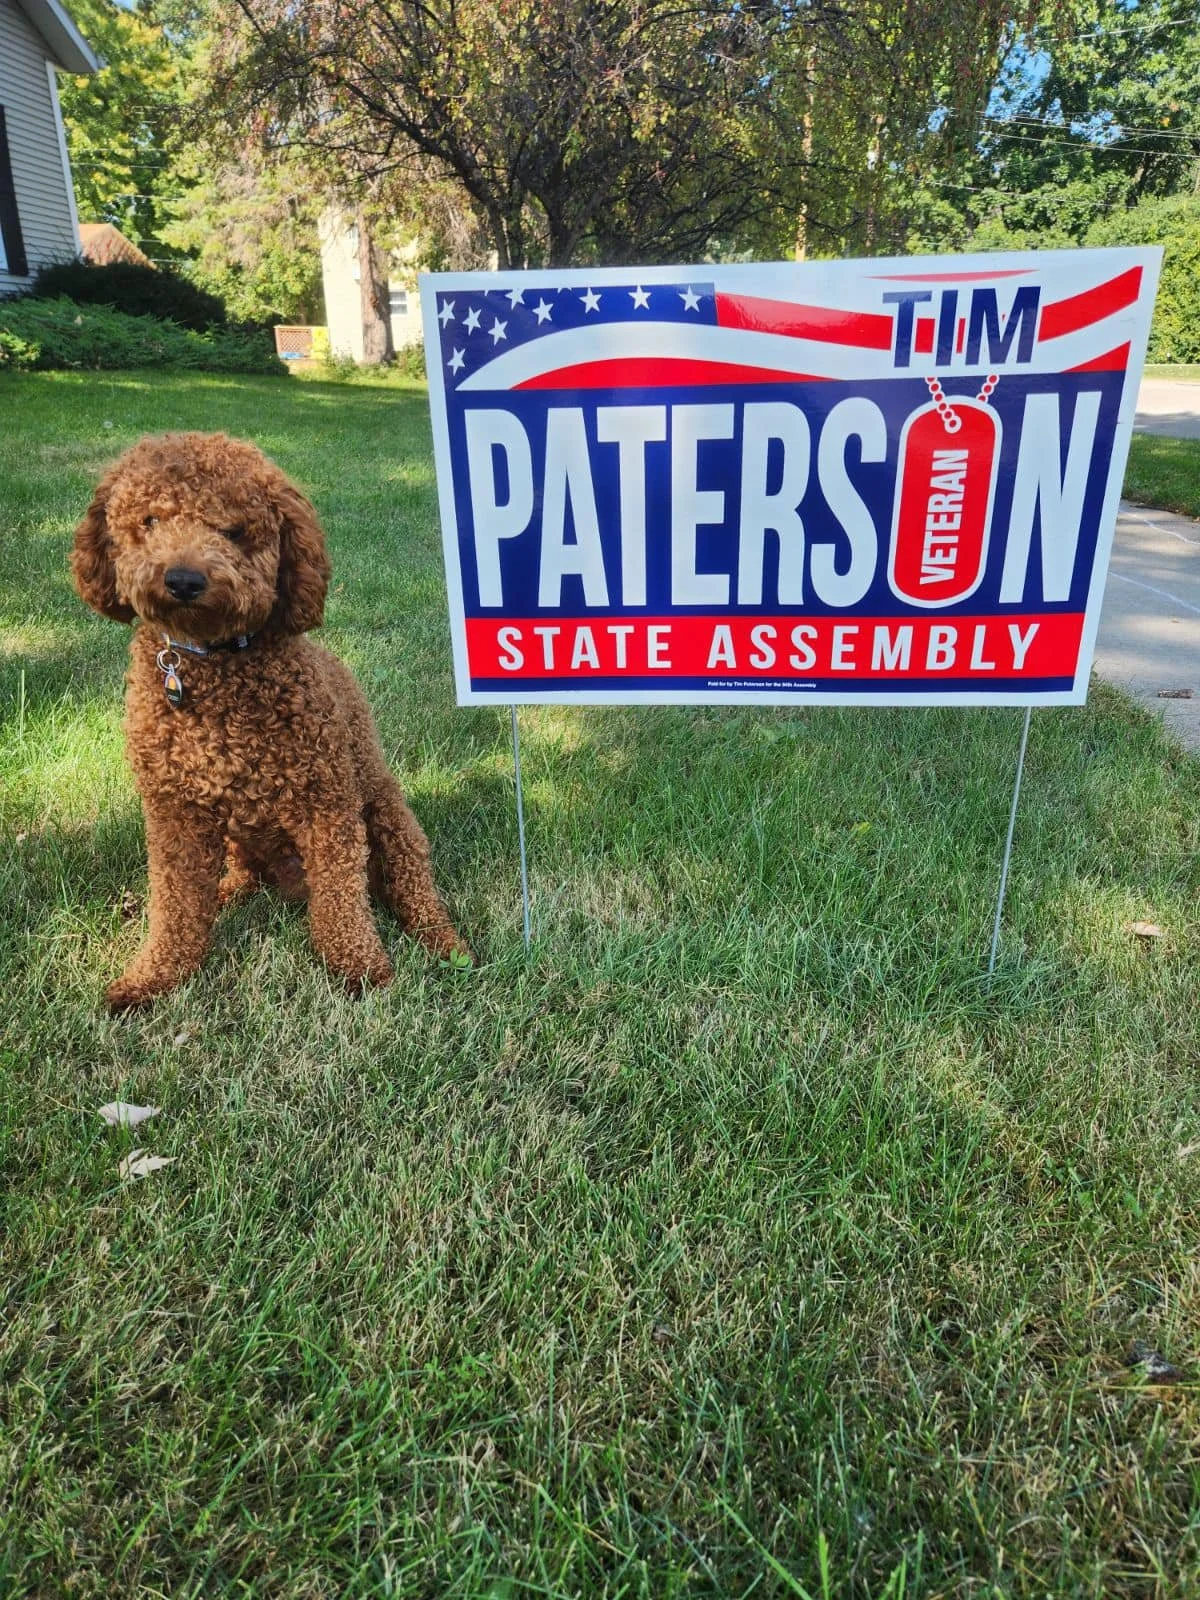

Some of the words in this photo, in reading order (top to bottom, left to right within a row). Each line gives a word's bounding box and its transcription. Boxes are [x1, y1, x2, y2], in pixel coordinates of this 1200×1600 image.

[882, 286, 1041, 368] TIM
[464, 390, 1102, 609] PATERSON
[919, 449, 969, 585] VETERAN
[496, 625, 672, 671] STATE
[706, 623, 1040, 671] ASSEMBLY
